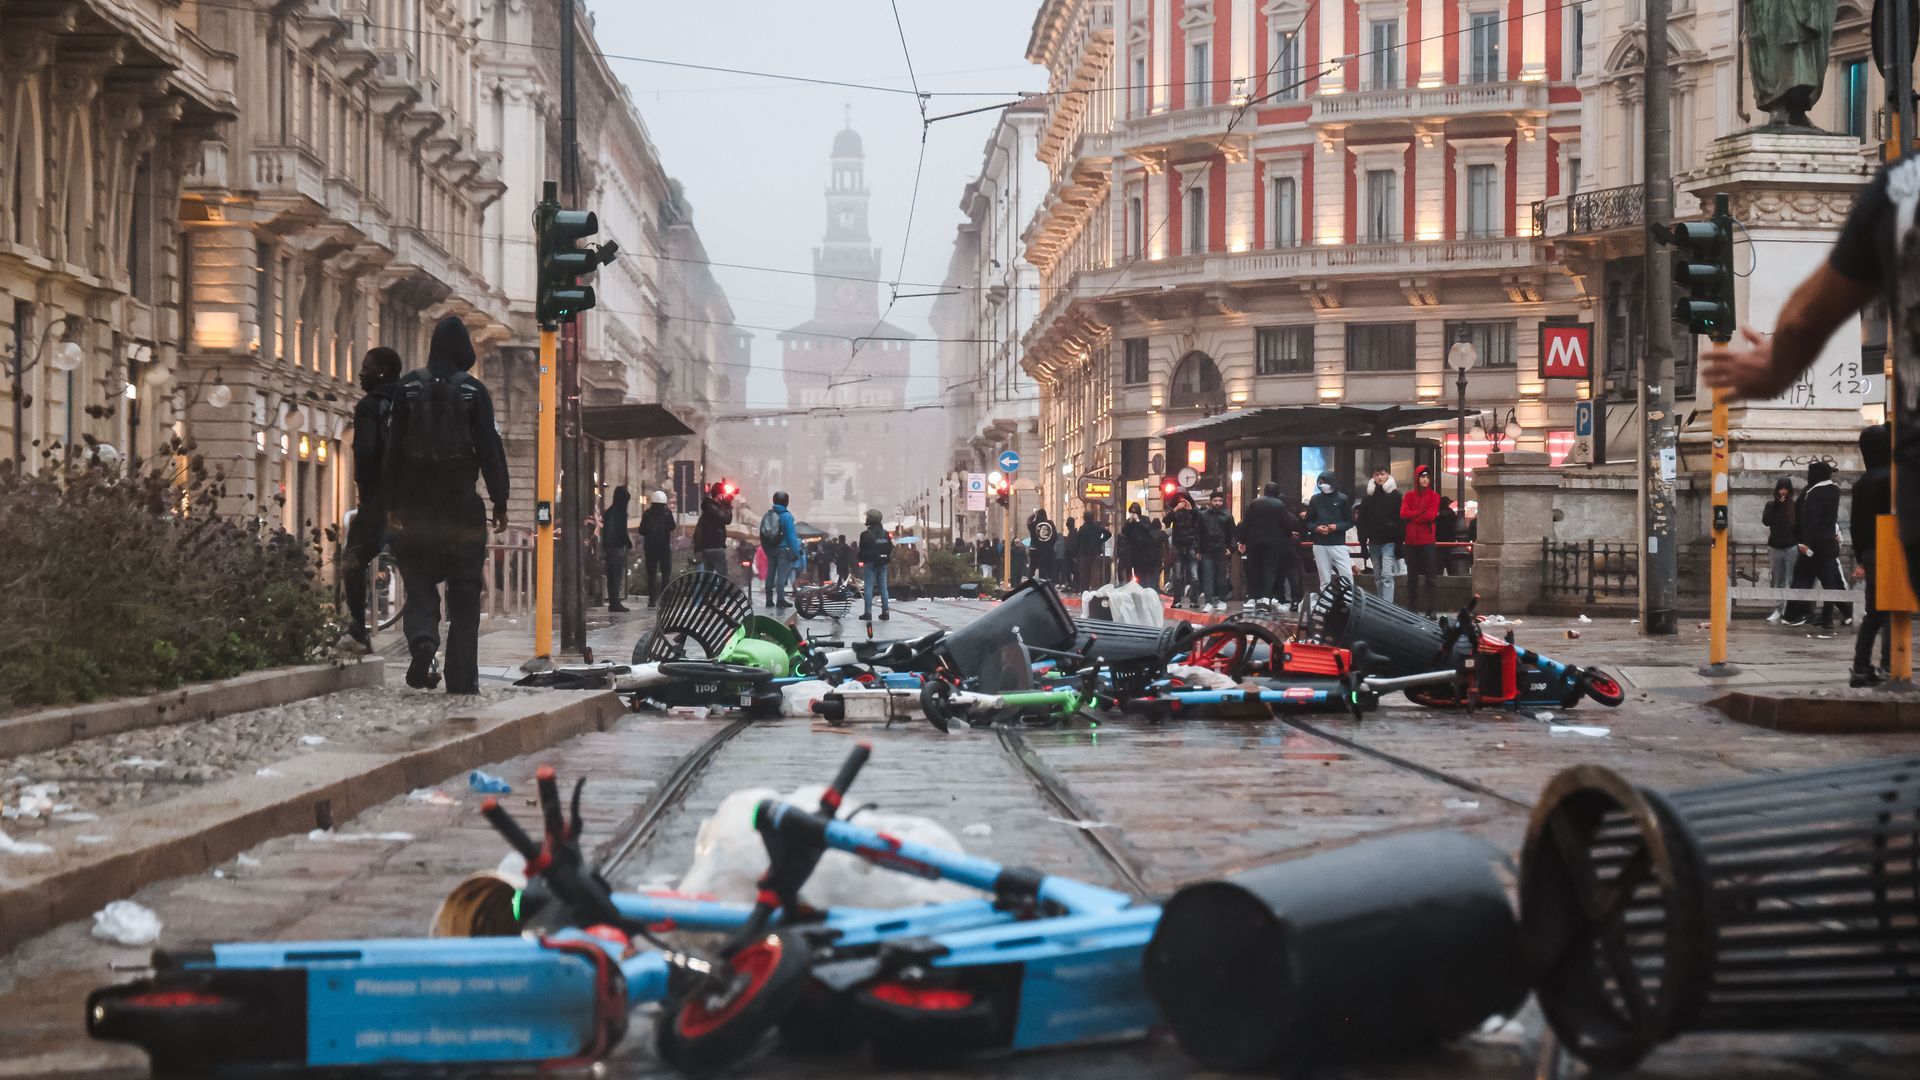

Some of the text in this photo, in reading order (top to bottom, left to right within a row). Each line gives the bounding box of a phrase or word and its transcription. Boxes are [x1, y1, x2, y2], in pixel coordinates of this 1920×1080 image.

[1547, 337, 1585, 367] M
[1830, 363, 1859, 378] 13
[1579, 407, 1589, 432] P
[1780, 454, 1839, 471] ACAB
